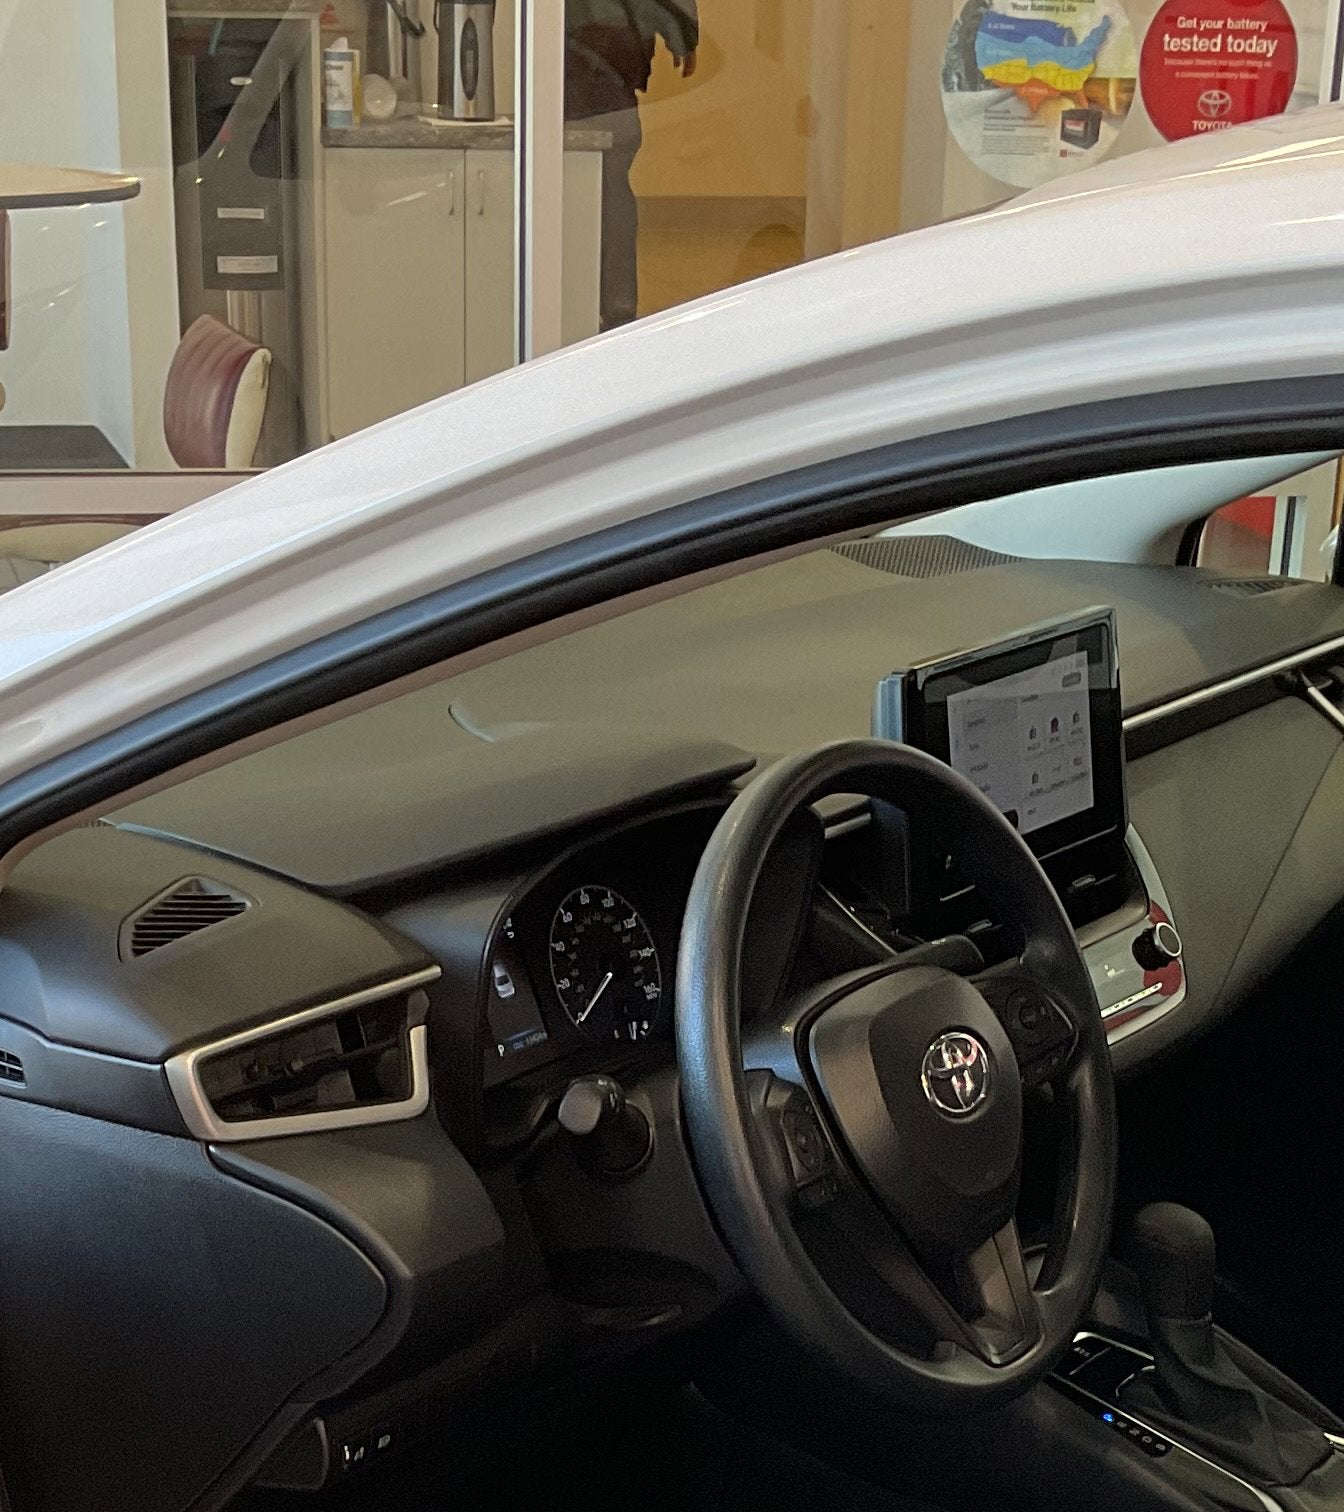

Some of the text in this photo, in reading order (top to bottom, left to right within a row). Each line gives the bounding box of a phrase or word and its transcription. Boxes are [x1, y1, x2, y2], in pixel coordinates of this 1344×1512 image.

[1011, 2, 1076, 13] Your Battery Life
[1177, 16, 1268, 32] Get your battery
[1163, 33, 1278, 57] tested today
[1192, 120, 1232, 131] TOYOTA
